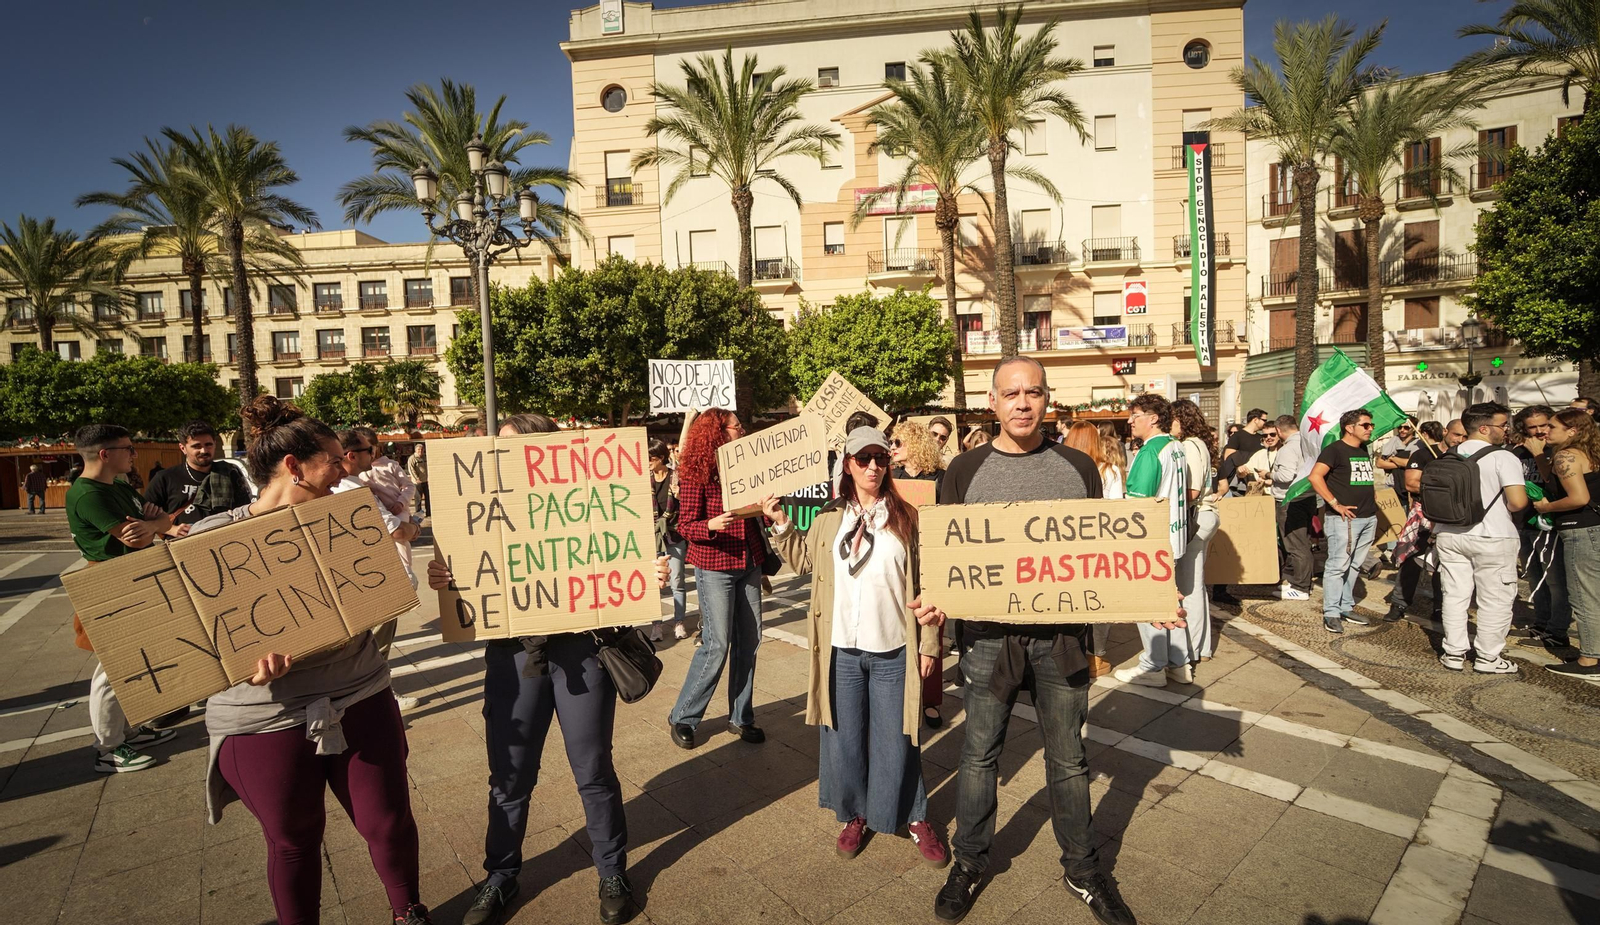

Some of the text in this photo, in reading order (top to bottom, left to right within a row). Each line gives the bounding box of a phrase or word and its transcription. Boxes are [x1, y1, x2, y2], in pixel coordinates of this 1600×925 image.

[1195, 158, 1210, 361] STOP GENOCIDIO PALESTINA
[1126, 305, 1146, 314] CGT
[652, 362, 733, 386] NOS DEJAN
[1115, 360, 1134, 369] CNT
[1397, 371, 1459, 381] FARMACIA
[1513, 366, 1563, 375] PUERTA
[652, 384, 731, 409] SIN CASAS
[816, 377, 844, 411] CASAS
[831, 387, 858, 418] GENTE
[453, 433, 643, 496] MI RIÑÓN
[726, 443, 746, 470] LA
[730, 450, 822, 496] ES UN DERECHO
[466, 483, 641, 536] PA PAGAR
[944, 517, 1005, 547] ALL
[1024, 512, 1148, 544] CASEROS
[132, 504, 384, 614] TURISTAS
[447, 530, 642, 592] LA ENTRADA
[947, 549, 1172, 590] ARE BASTARDS
[176, 556, 387, 660] VECINAS
[455, 569, 647, 630] DE UN PISO
